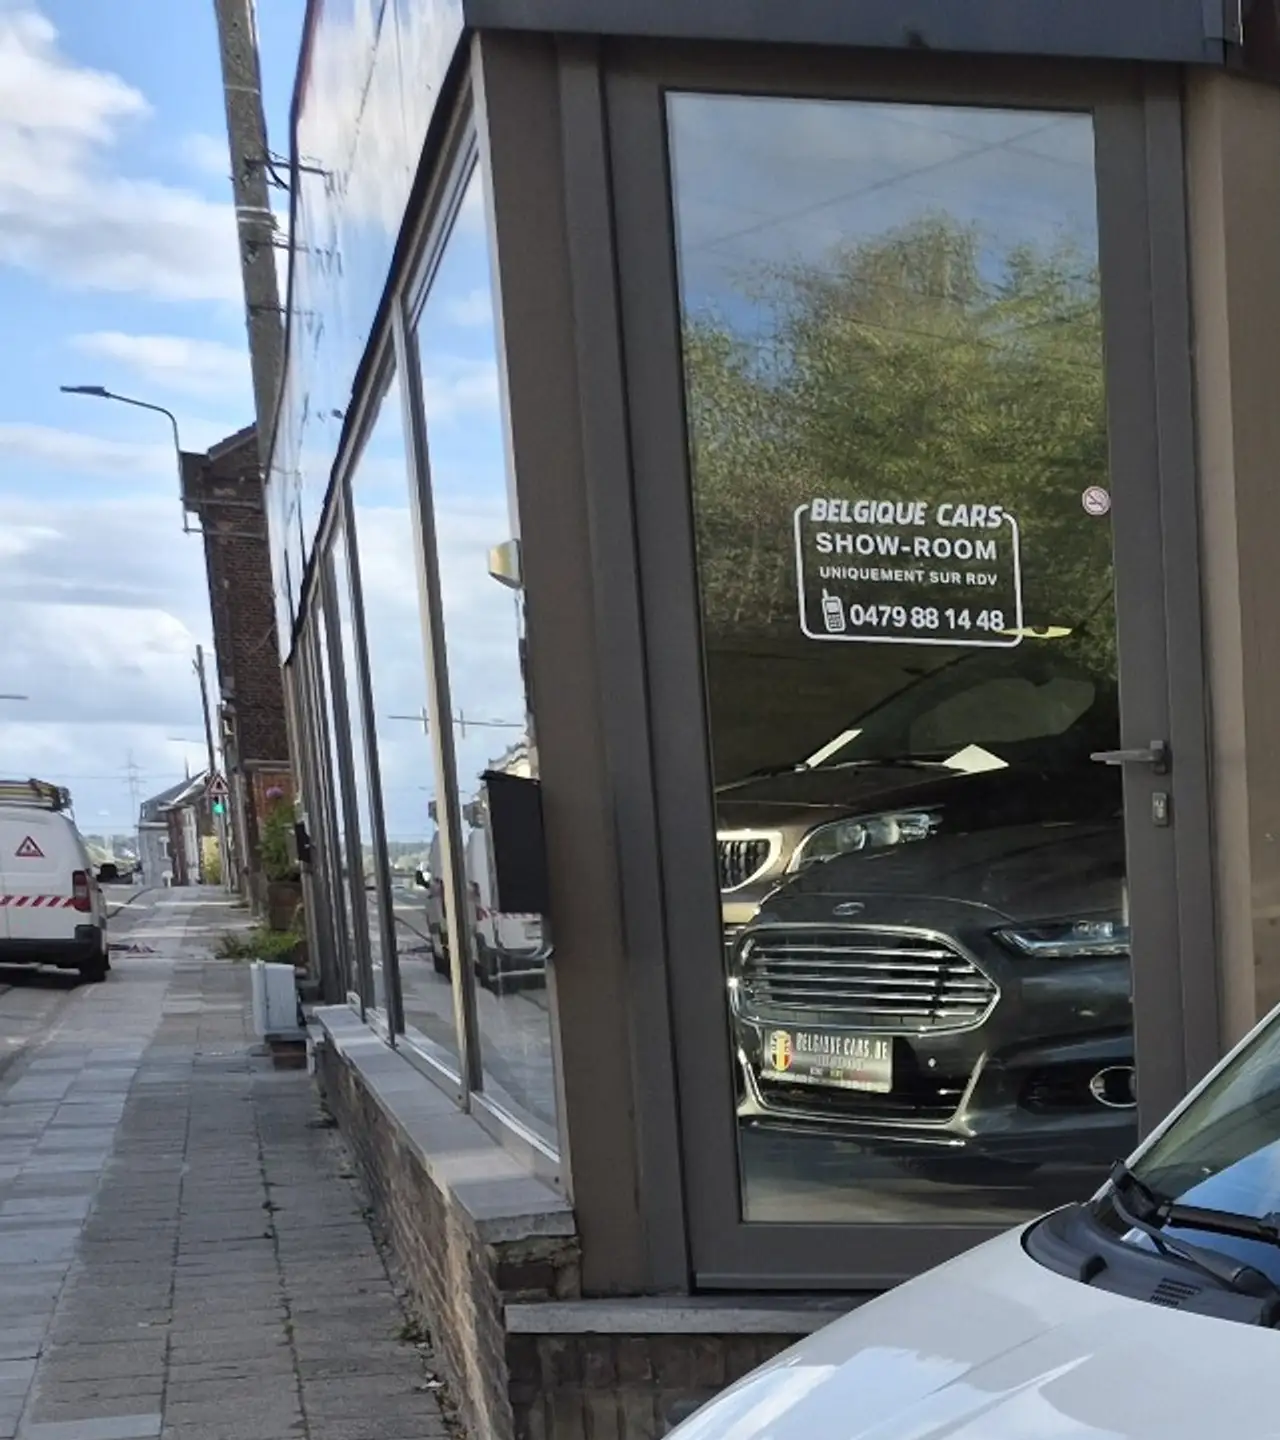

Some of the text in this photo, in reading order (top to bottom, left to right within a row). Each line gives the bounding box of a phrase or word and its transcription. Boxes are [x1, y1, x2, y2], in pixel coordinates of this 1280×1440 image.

[810, 498, 1003, 528] BELGIQUE CARS
[816, 532, 996, 560] SHOW-ROOM
[820, 566, 998, 586] UNIQUEMENT SUR RDV
[851, 604, 1004, 632] 0479 88 14 48
